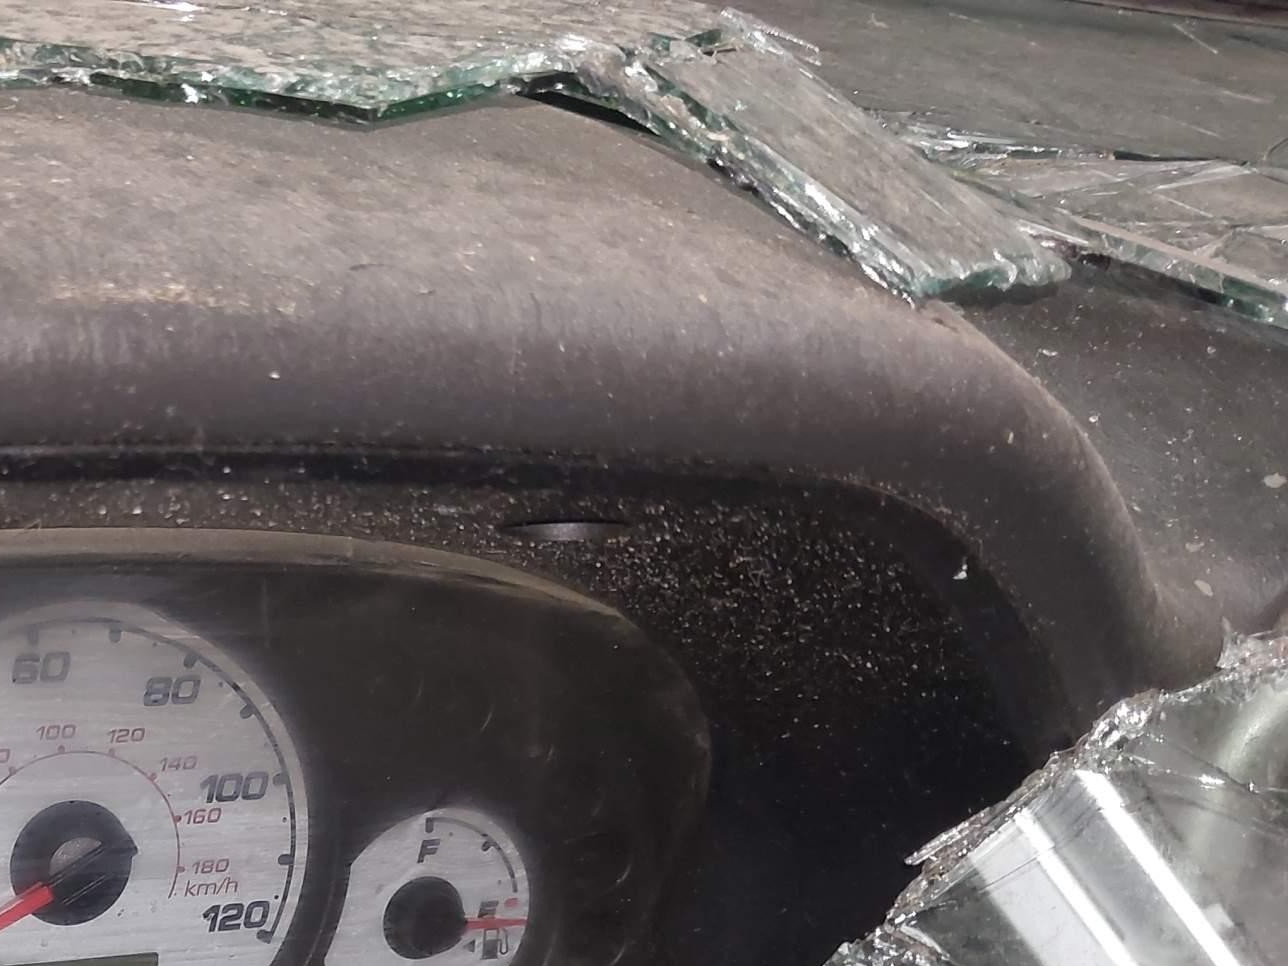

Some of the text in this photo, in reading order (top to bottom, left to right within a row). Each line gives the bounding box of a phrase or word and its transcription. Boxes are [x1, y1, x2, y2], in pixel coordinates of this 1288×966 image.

[13, 651, 72, 684] 60
[143, 675, 202, 707] 80
[36, 724, 76, 741] 100
[108, 727, 145, 744] 120
[160, 755, 198, 773] 140
[199, 771, 268, 804] 100
[184, 807, 222, 825] 160
[417, 838, 440, 864] F
[192, 857, 230, 874] 180
[183, 876, 239, 898] km/h
[202, 900, 270, 933] 120
